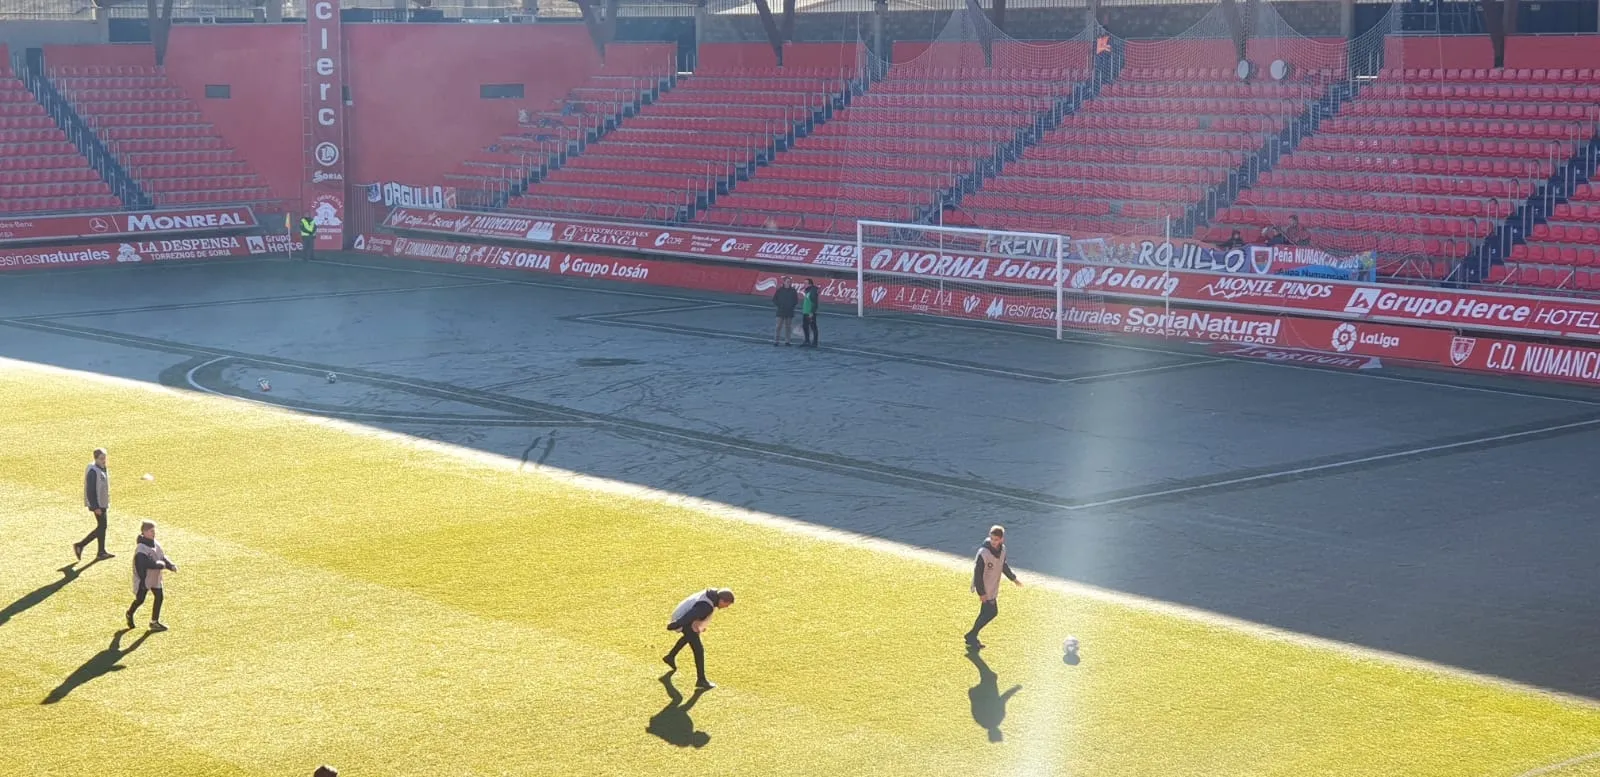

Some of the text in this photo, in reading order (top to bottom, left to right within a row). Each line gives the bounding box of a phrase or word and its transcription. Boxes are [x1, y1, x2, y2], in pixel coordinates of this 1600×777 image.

[384, 182, 443, 209] ORGULLO
[127, 212, 246, 232] MONREAL
[471, 216, 531, 232] PAVIMENTOS
[579, 227, 649, 238] CONSTRUCCIONES
[579, 235, 637, 246] ARANGA
[139, 237, 241, 253] LA DESPENSA
[151, 248, 231, 261] TORREZNOS DE SORIA
[267, 242, 304, 253] Herce
[758, 242, 811, 257] KOUSA.es
[1138, 241, 1245, 273] ROJILLO
[1273, 247, 1293, 263] Peña
[572, 258, 649, 279] Grupo Losán
[893, 252, 989, 279] NORMA
[1095, 268, 1179, 296] Solarig
[1215, 277, 1333, 298] MONTE PINOS
[1377, 293, 1600, 328] Grupo Herce HOTEL
[1126, 307, 1280, 337] SoriaNatural
[1123, 326, 1190, 337] EFICACIA
[1208, 332, 1276, 345] CALIDAD
[1359, 332, 1400, 348] LaLiga
[1487, 342, 1600, 380] C.D. NUMANCI
